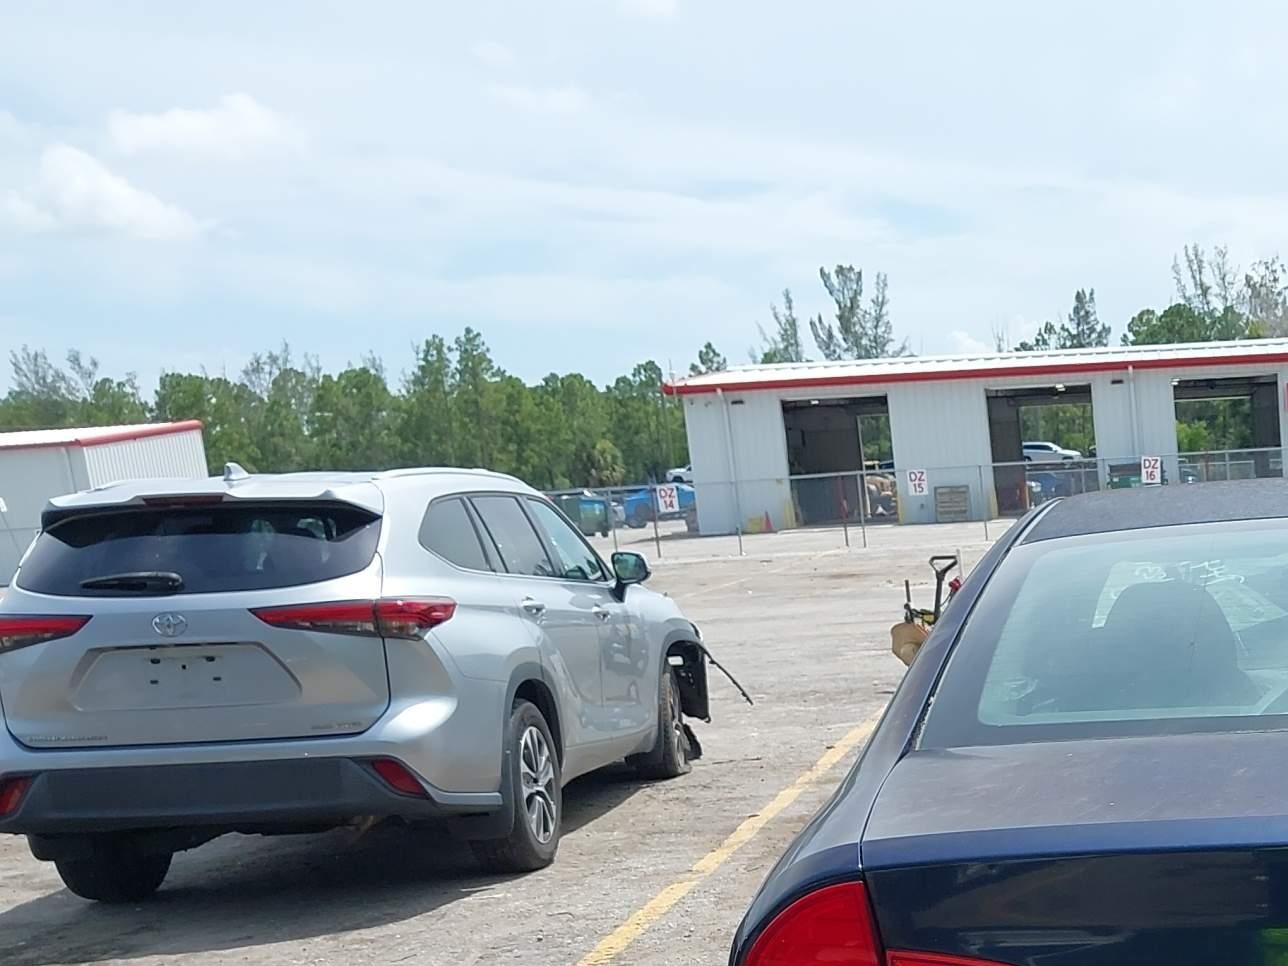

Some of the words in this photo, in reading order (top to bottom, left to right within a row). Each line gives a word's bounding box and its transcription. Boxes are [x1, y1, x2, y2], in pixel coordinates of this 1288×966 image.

[1143, 458, 1159, 470] DZ
[909, 471, 925, 482] DZ
[1145, 470, 1156, 481] 16
[659, 487, 675, 498] DZ
[913, 483, 924, 493] 15
[663, 499, 675, 509] 14
